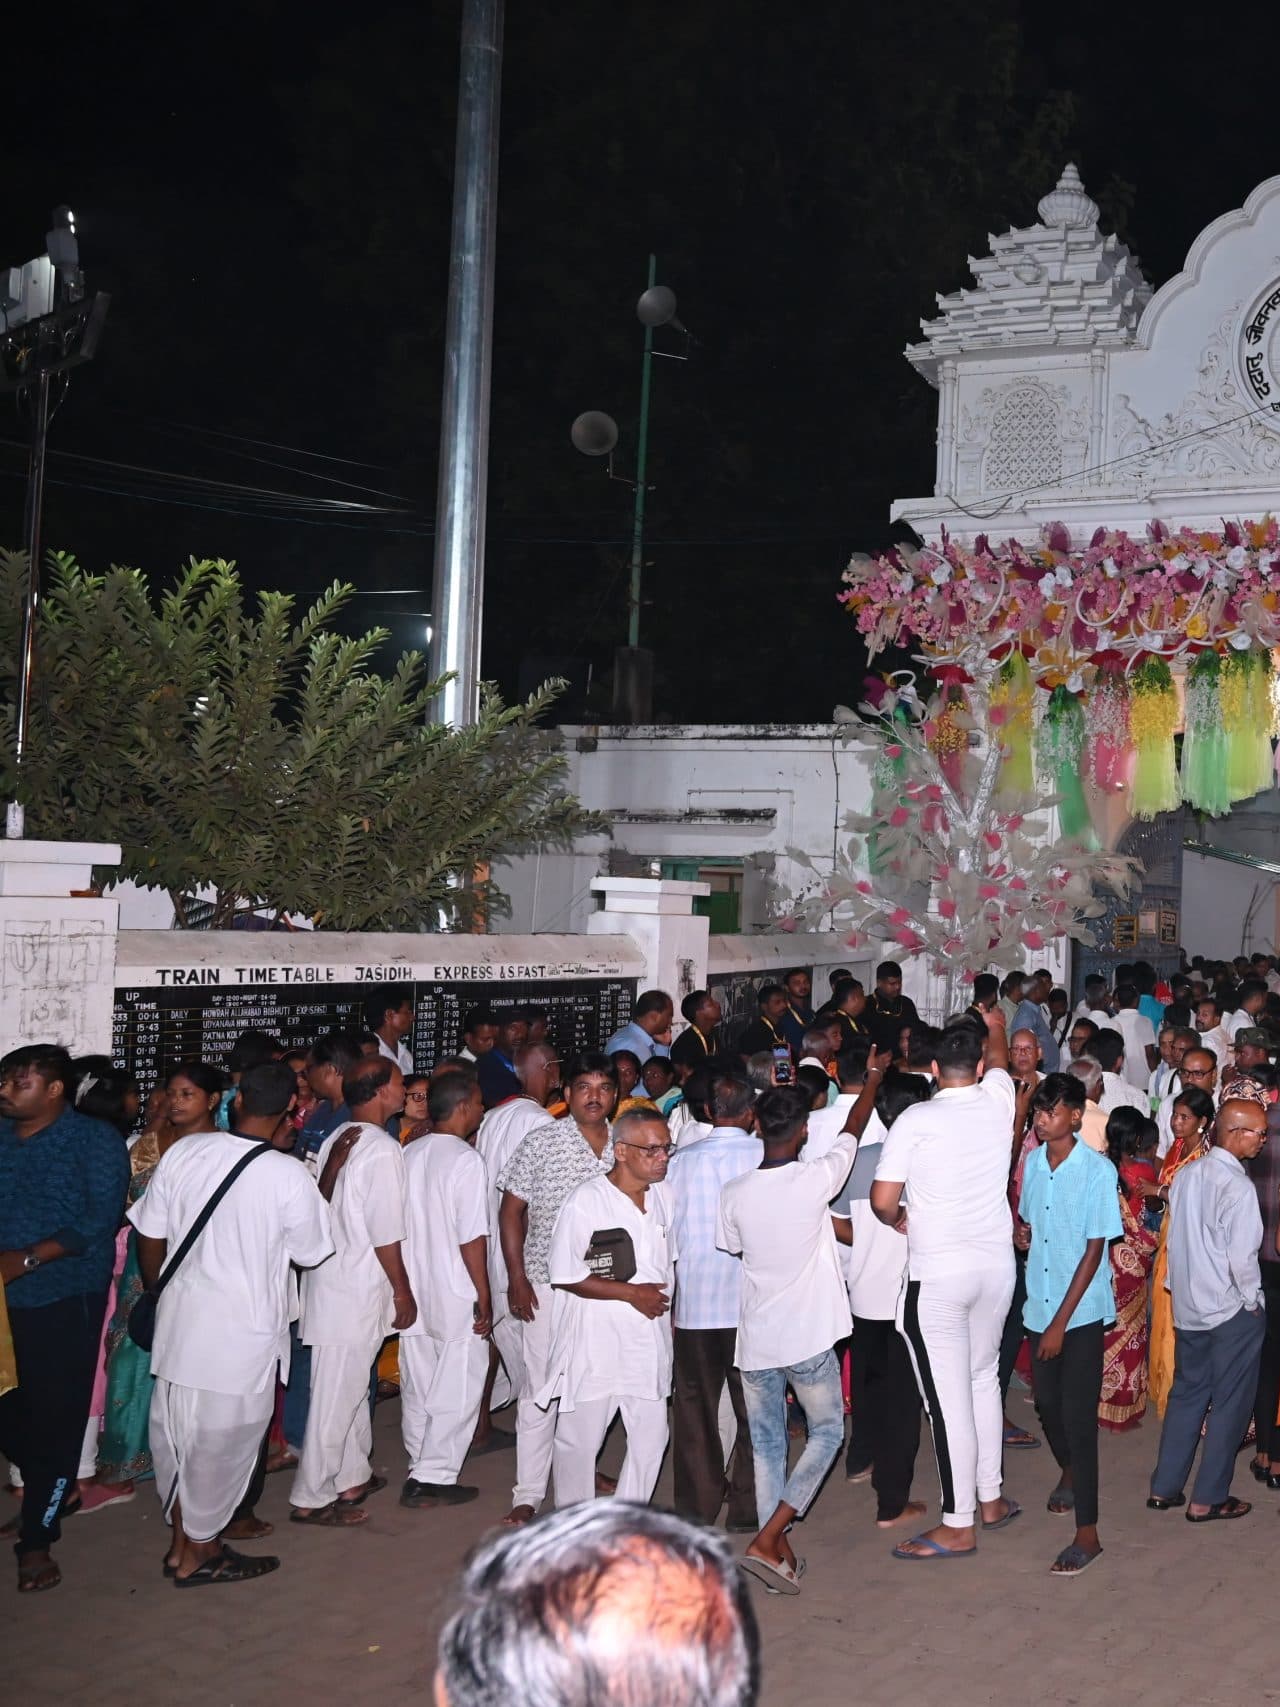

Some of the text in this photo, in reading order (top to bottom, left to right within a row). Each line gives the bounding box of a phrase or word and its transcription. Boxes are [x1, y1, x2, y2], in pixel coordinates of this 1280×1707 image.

[156, 968, 220, 985] TRAIN
[434, 966, 493, 979] EXPRESS
[125, 992, 140, 1001] UP
[170, 1011, 189, 1019] DAILY
[202, 1009, 229, 1018] HOWRAH
[231, 1007, 261, 1016] ALLAHABAD
[250, 1018, 276, 1026] TOOFAN
[287, 1017, 300, 1025] EXP
[202, 1032, 226, 1040] PATNA
[318, 1026, 331, 1035] EXP
